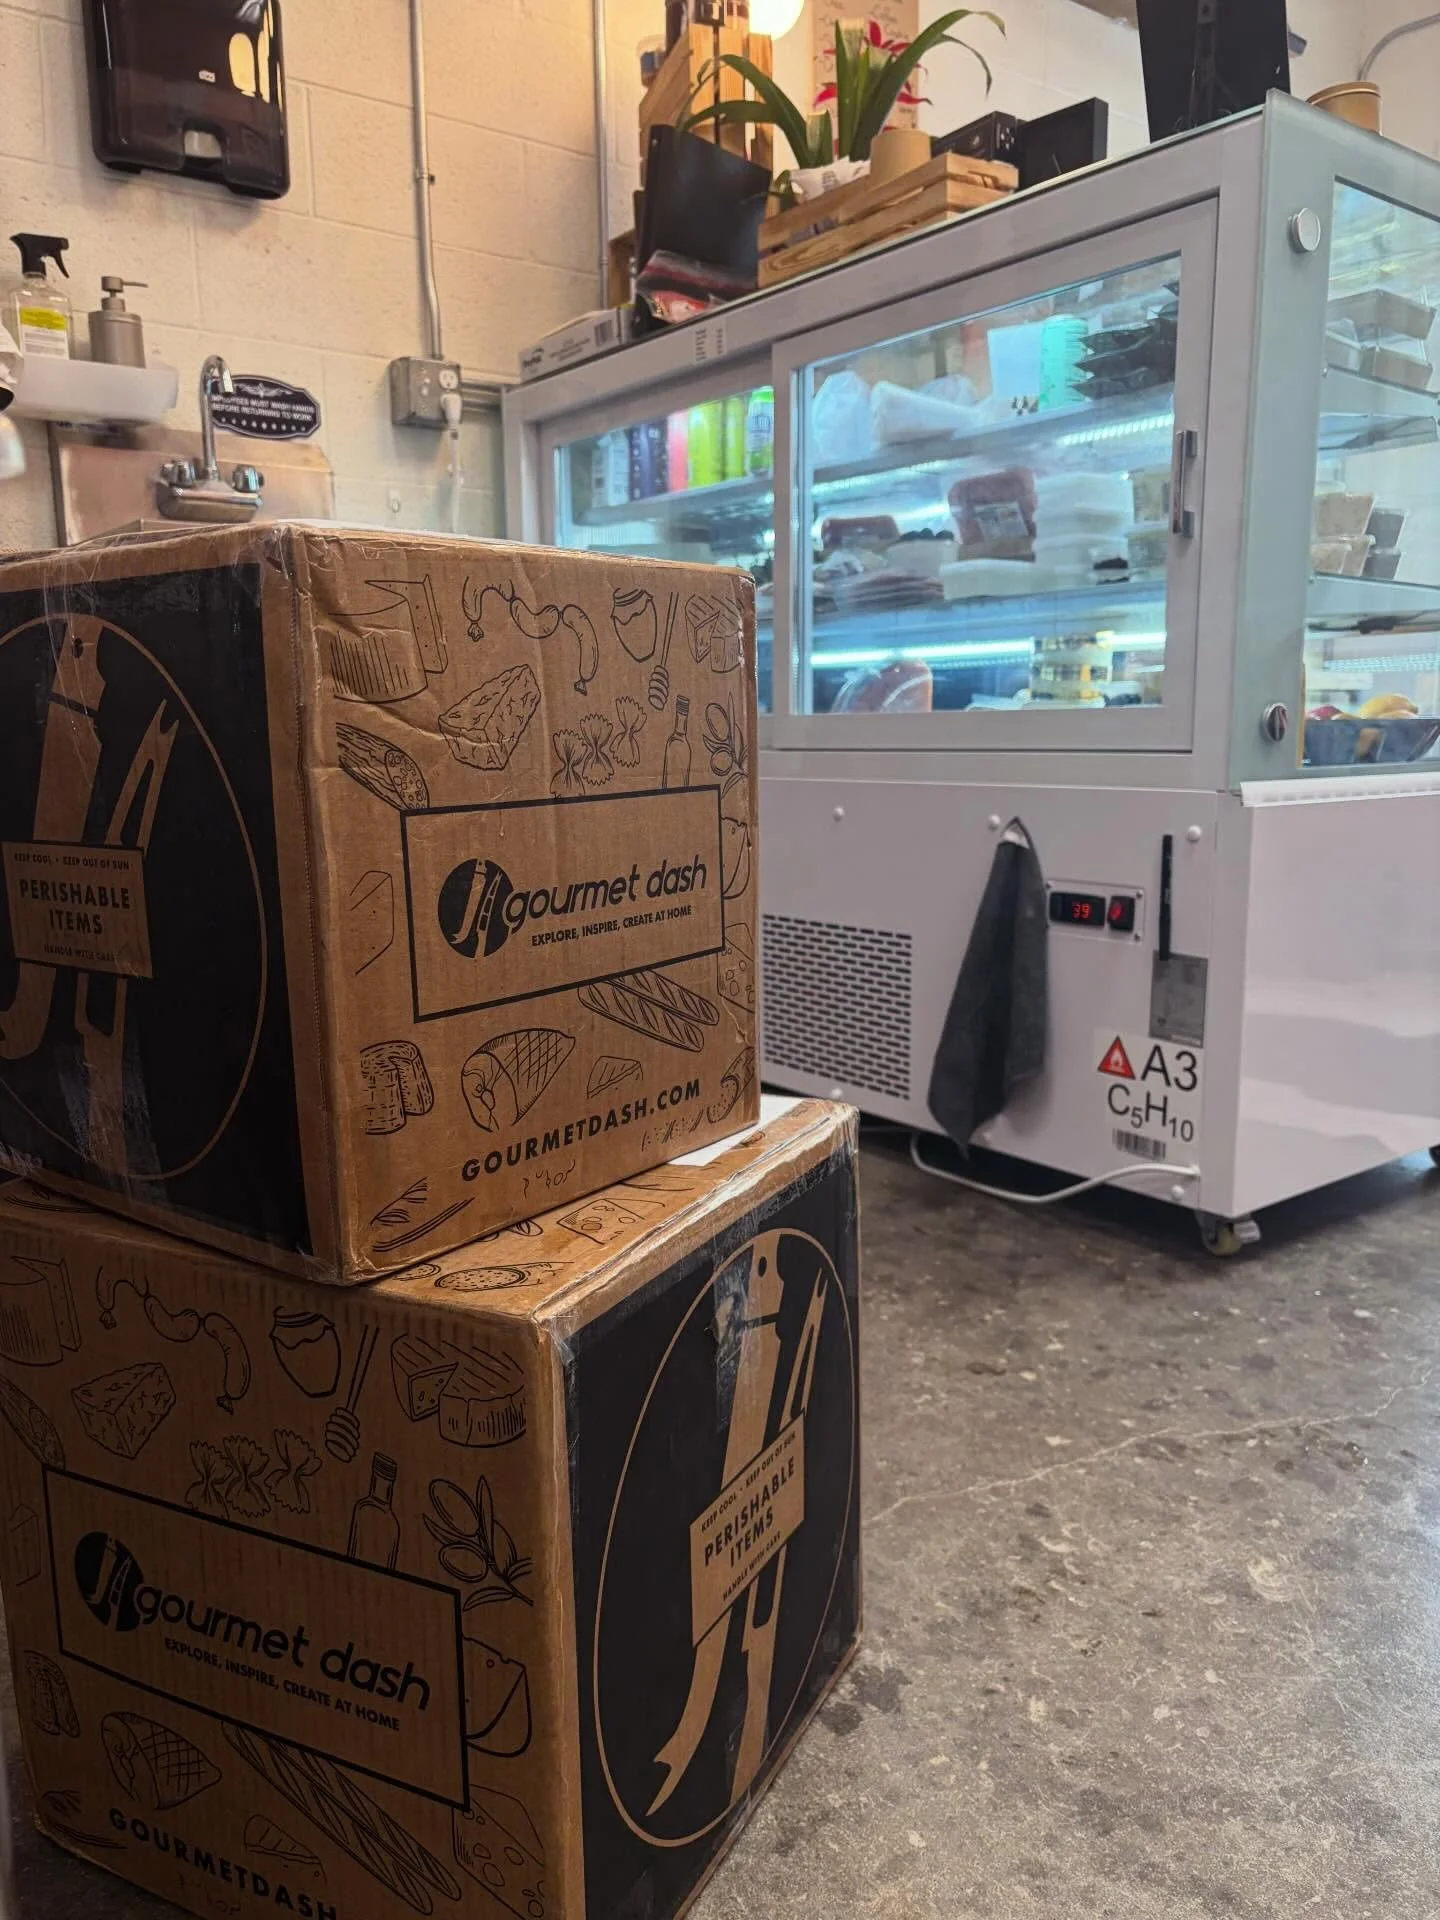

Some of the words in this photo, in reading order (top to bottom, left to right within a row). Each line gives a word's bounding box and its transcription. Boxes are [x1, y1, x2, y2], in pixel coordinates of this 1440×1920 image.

[14, 853, 30, 863] KEEP
[32, 854, 51, 865] COOL
[63, 856, 81, 866] KEEP
[82, 858, 98, 869] OUT
[101, 860, 111, 870] OF
[112, 860, 130, 871] SUN
[19, 879, 130, 909] PERISHABLE
[49, 909, 103, 935] ITEMS
[503, 864, 640, 935] gourmet
[646, 855, 707, 898] dash
[1072, 902, 1091, 920] 39
[531, 928, 580, 947] EXPLORE,
[582, 920, 621, 938] INSPIRE,
[622, 913, 653, 929] CREATE
[654, 911, 666, 923] AT
[667, 905, 692, 920] HOME
[1140, 1044, 1198, 1092] A3
[461, 1078, 700, 1182] GOURMETDASH.COM
[701, 1509, 718, 1533] KEEP
[719, 1491, 737, 1514] COOL
[745, 1467, 760, 1488] KEEP
[761, 1453, 774, 1471] OUT
[775, 1444, 783, 1457] OF
[704, 1456, 795, 1567] PERISHABLE
[729, 1506, 774, 1568] ITEMS
[722, 1567, 748, 1601] HANDLE
[749, 1548, 765, 1570] WITH
[134, 1585, 309, 1669] gourmet
[320, 1641, 431, 1711] dash
[164, 1637, 223, 1669] EXPLORE,
[225, 1658, 279, 1690] INSPIRE,
[282, 1680, 331, 1707] CREATE
[334, 1697, 353, 1713] AT
[355, 1705, 400, 1731] HOME
